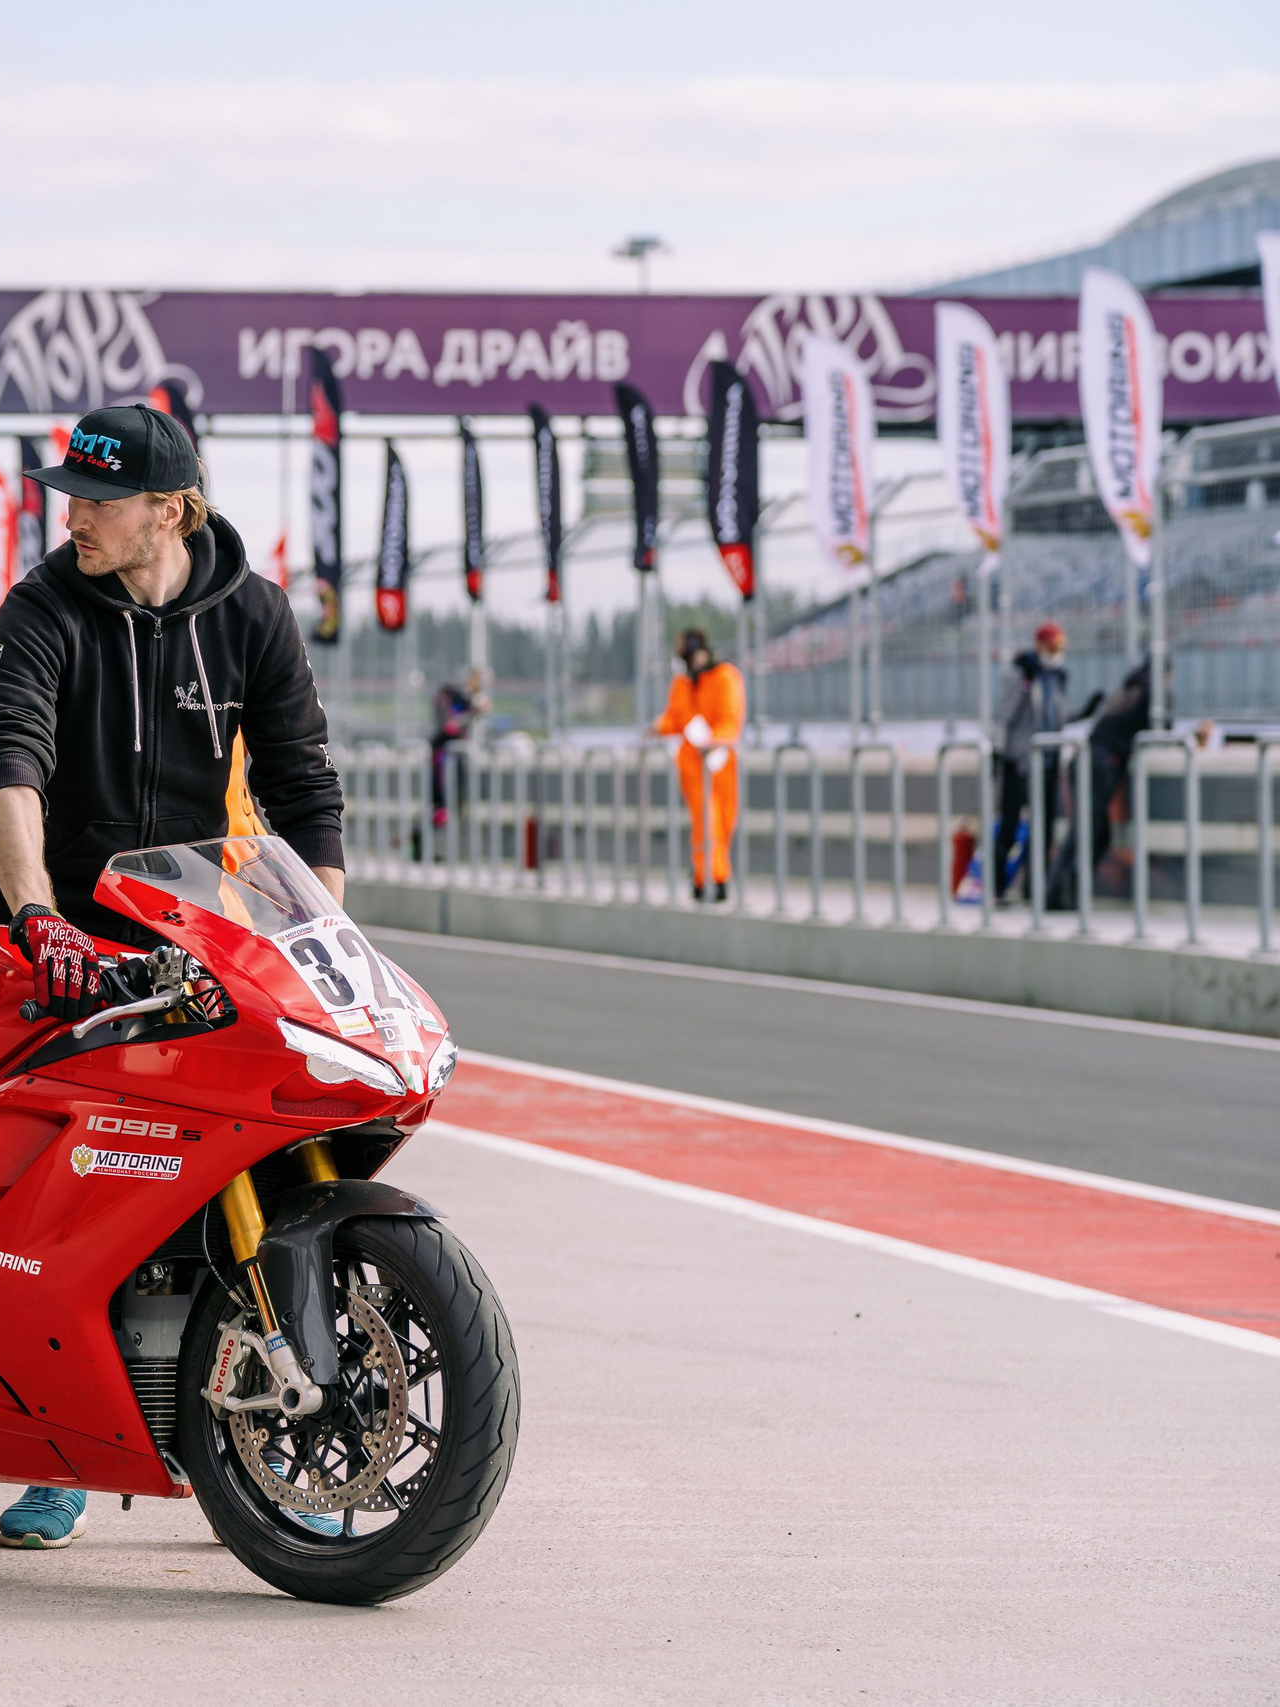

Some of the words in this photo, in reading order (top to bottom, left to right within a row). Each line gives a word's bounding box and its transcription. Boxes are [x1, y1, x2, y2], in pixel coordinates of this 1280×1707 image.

[237, 326, 429, 381] ИГОРА
[433, 319, 632, 388] ДРАЙВ
[1106, 310, 1135, 499] MOTORING
[87, 454, 109, 469] team
[201, 703, 222, 711] MTO
[290, 928, 407, 1010] 32
[384, 1027, 397, 1041] D
[86, 1115, 178, 1140] 1098
[94, 1151, 181, 1172] MOTORING
[96, 1167, 131, 1175] ЧЕМПИОНАТ
[133, 1169, 158, 1177] РОССИИ
[213, 1338, 235, 1394] brembo
